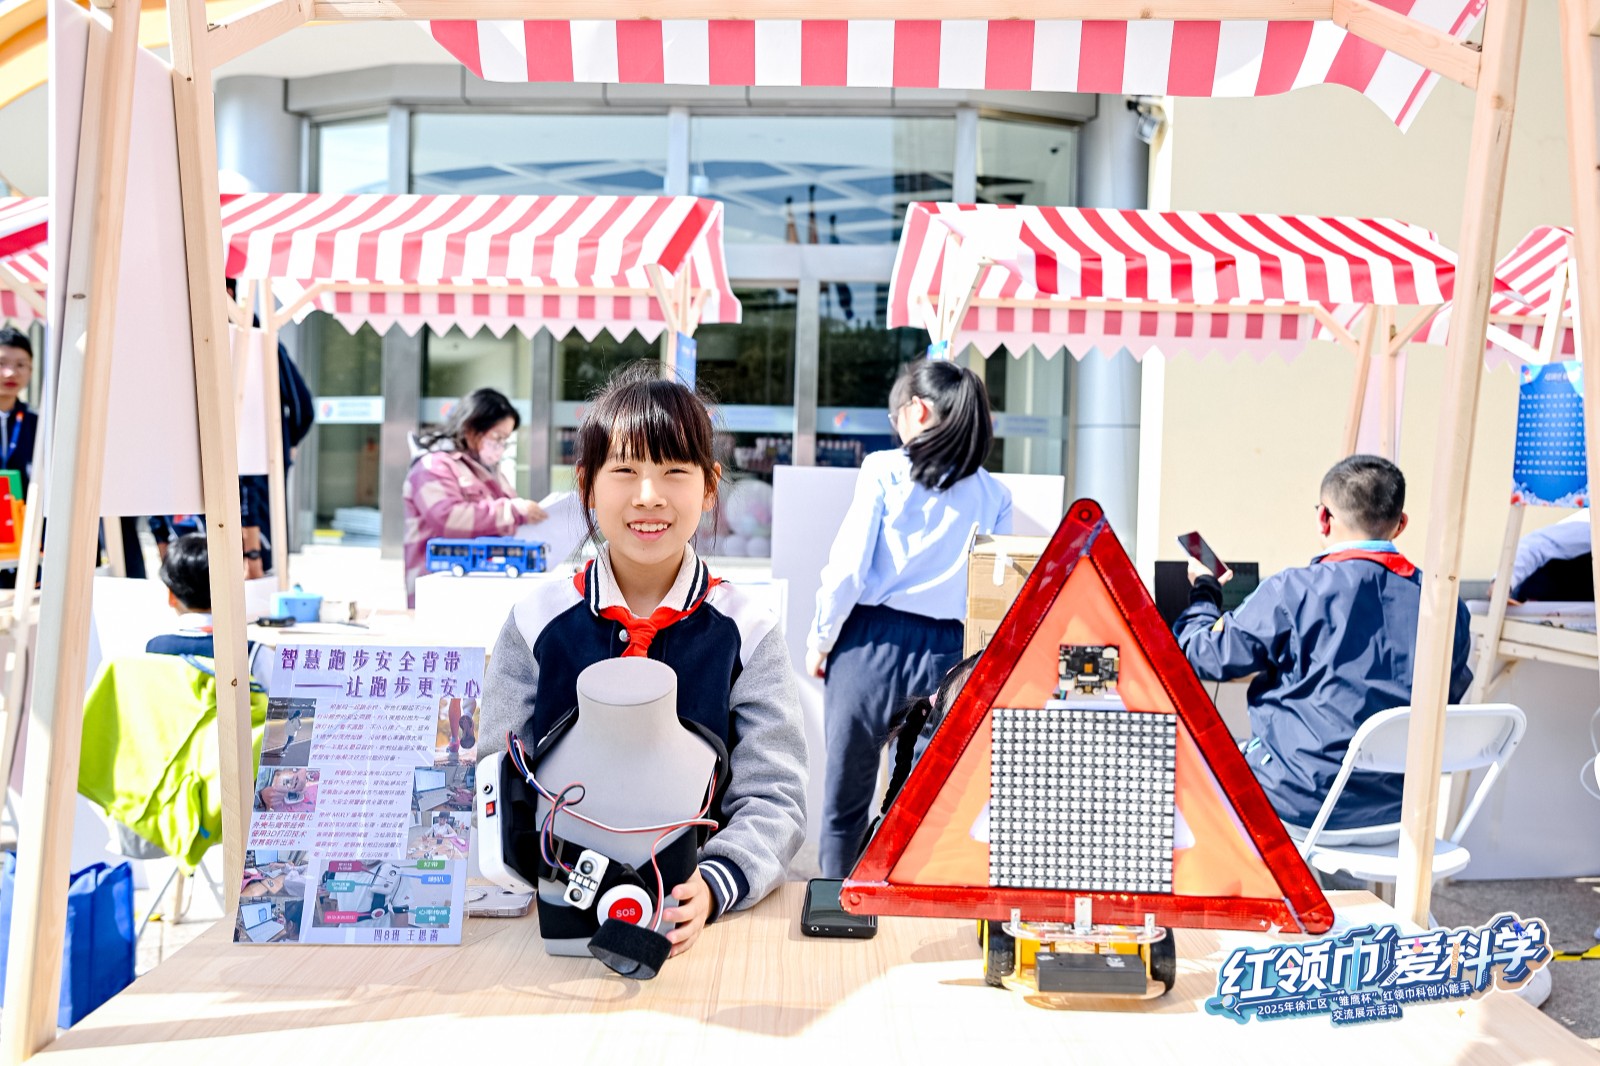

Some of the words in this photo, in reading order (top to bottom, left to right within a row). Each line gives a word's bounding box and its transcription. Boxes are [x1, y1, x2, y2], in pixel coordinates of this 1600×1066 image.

[281, 648, 462, 672] 智慧跑步安全背带
[251, 830, 307, 838] 使用3D打印技术
[616, 908, 636, 918] SOS
[373, 928, 400, 942] 四8班
